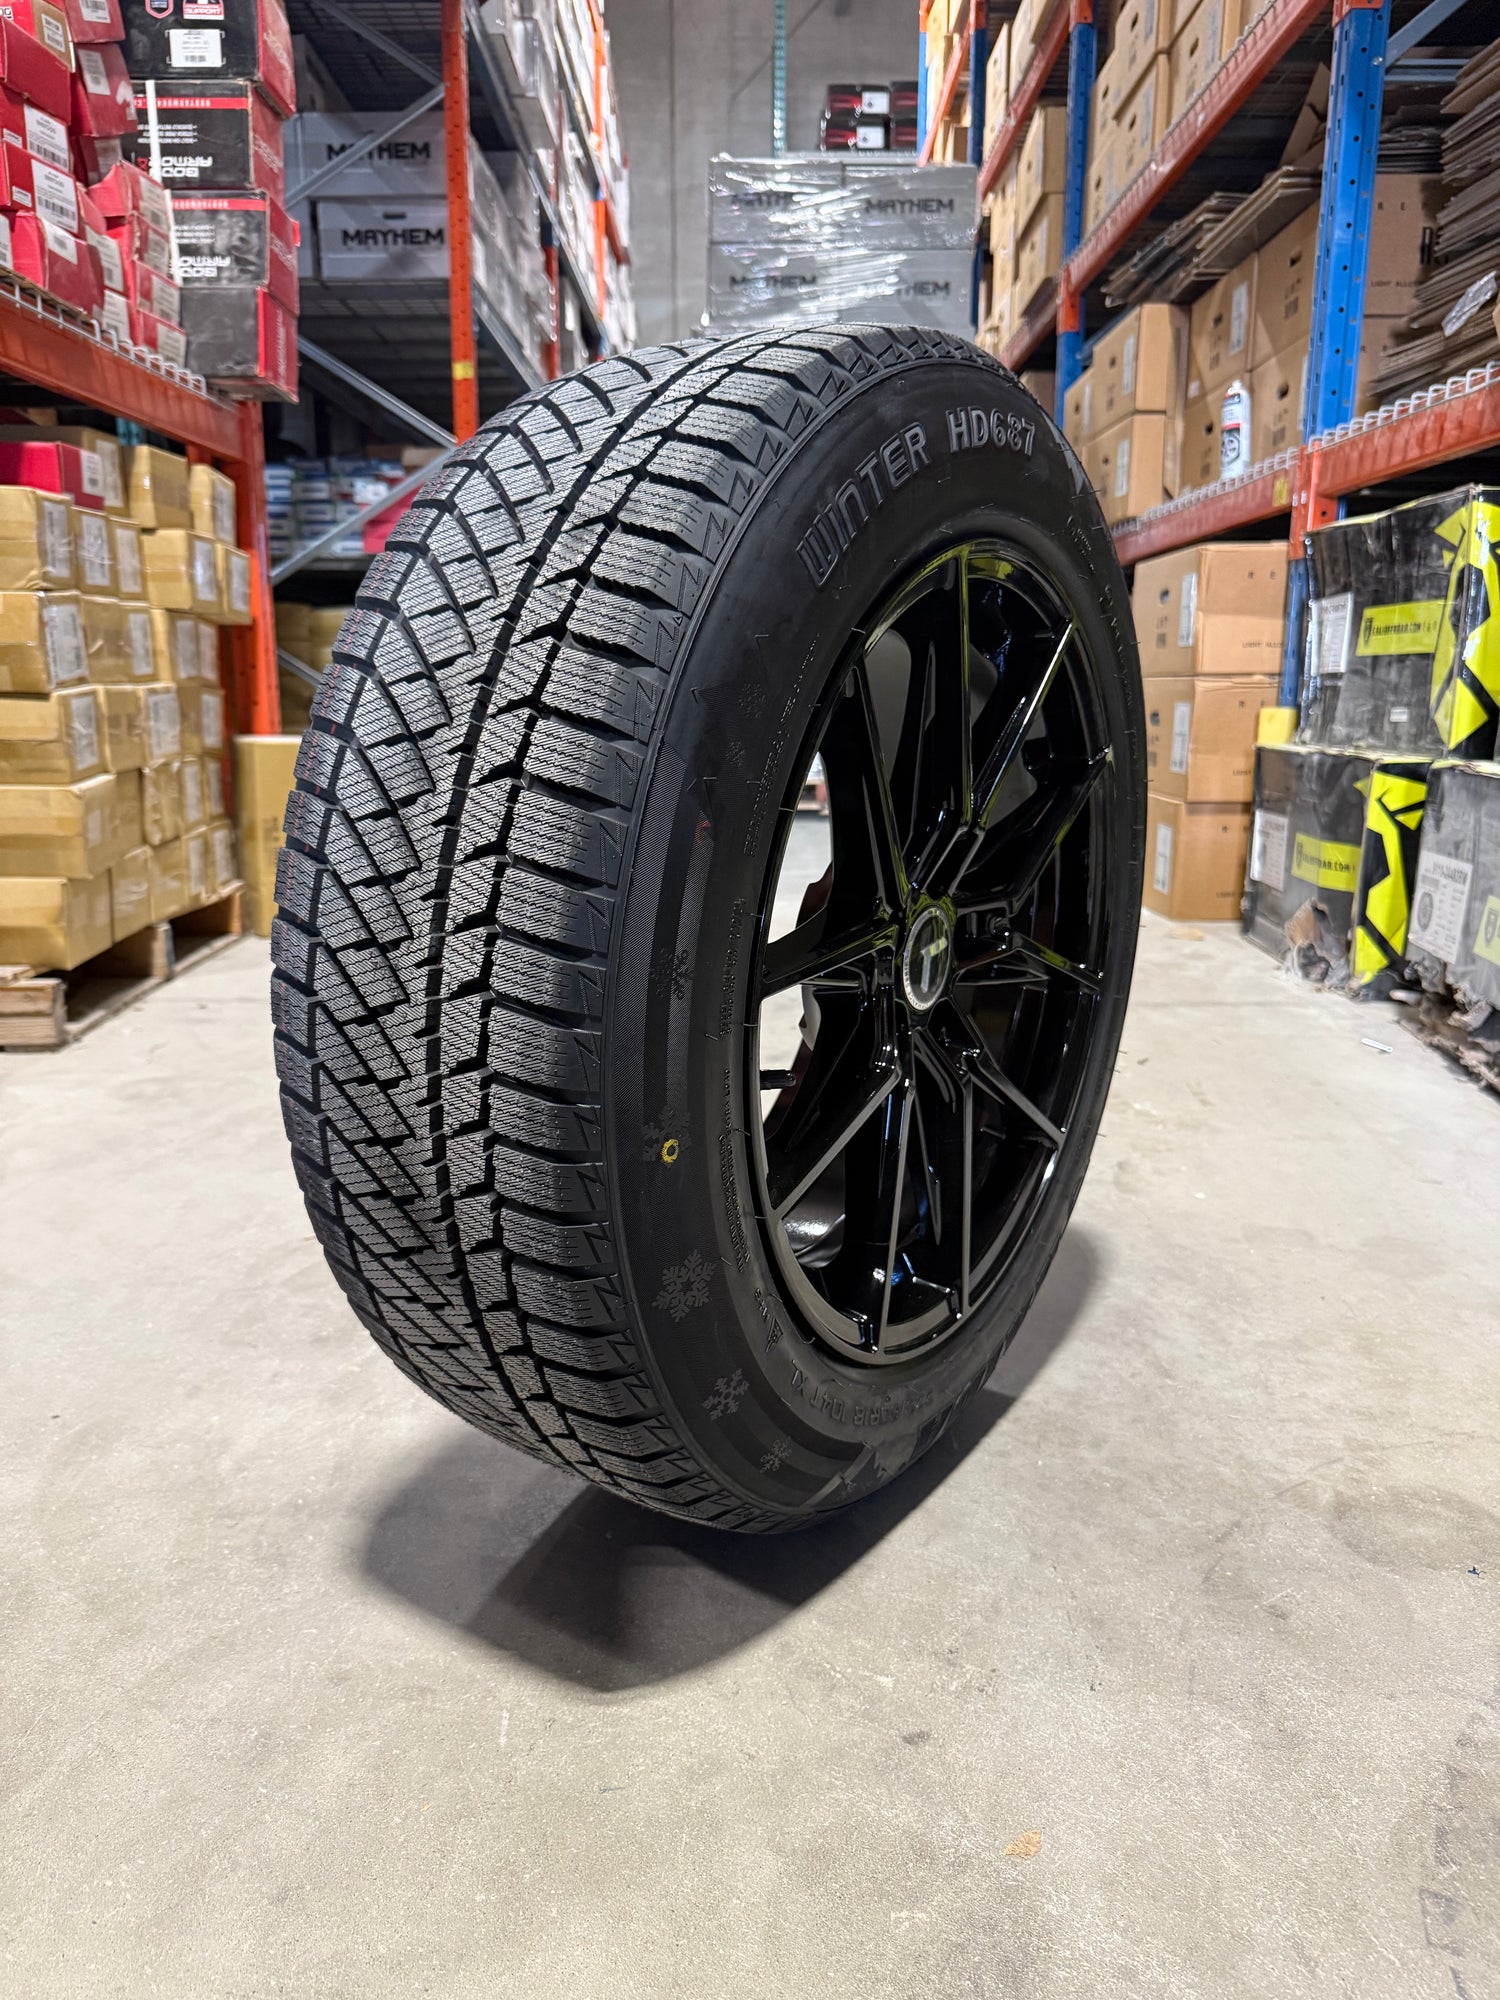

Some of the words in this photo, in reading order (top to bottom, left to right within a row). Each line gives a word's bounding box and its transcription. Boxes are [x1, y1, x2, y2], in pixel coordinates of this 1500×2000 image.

[326, 142, 431, 161] MHEM
[342, 228, 445, 247] MAYHEM
[795, 421, 932, 587] WINTER
[946, 405, 1037, 457] HD687
